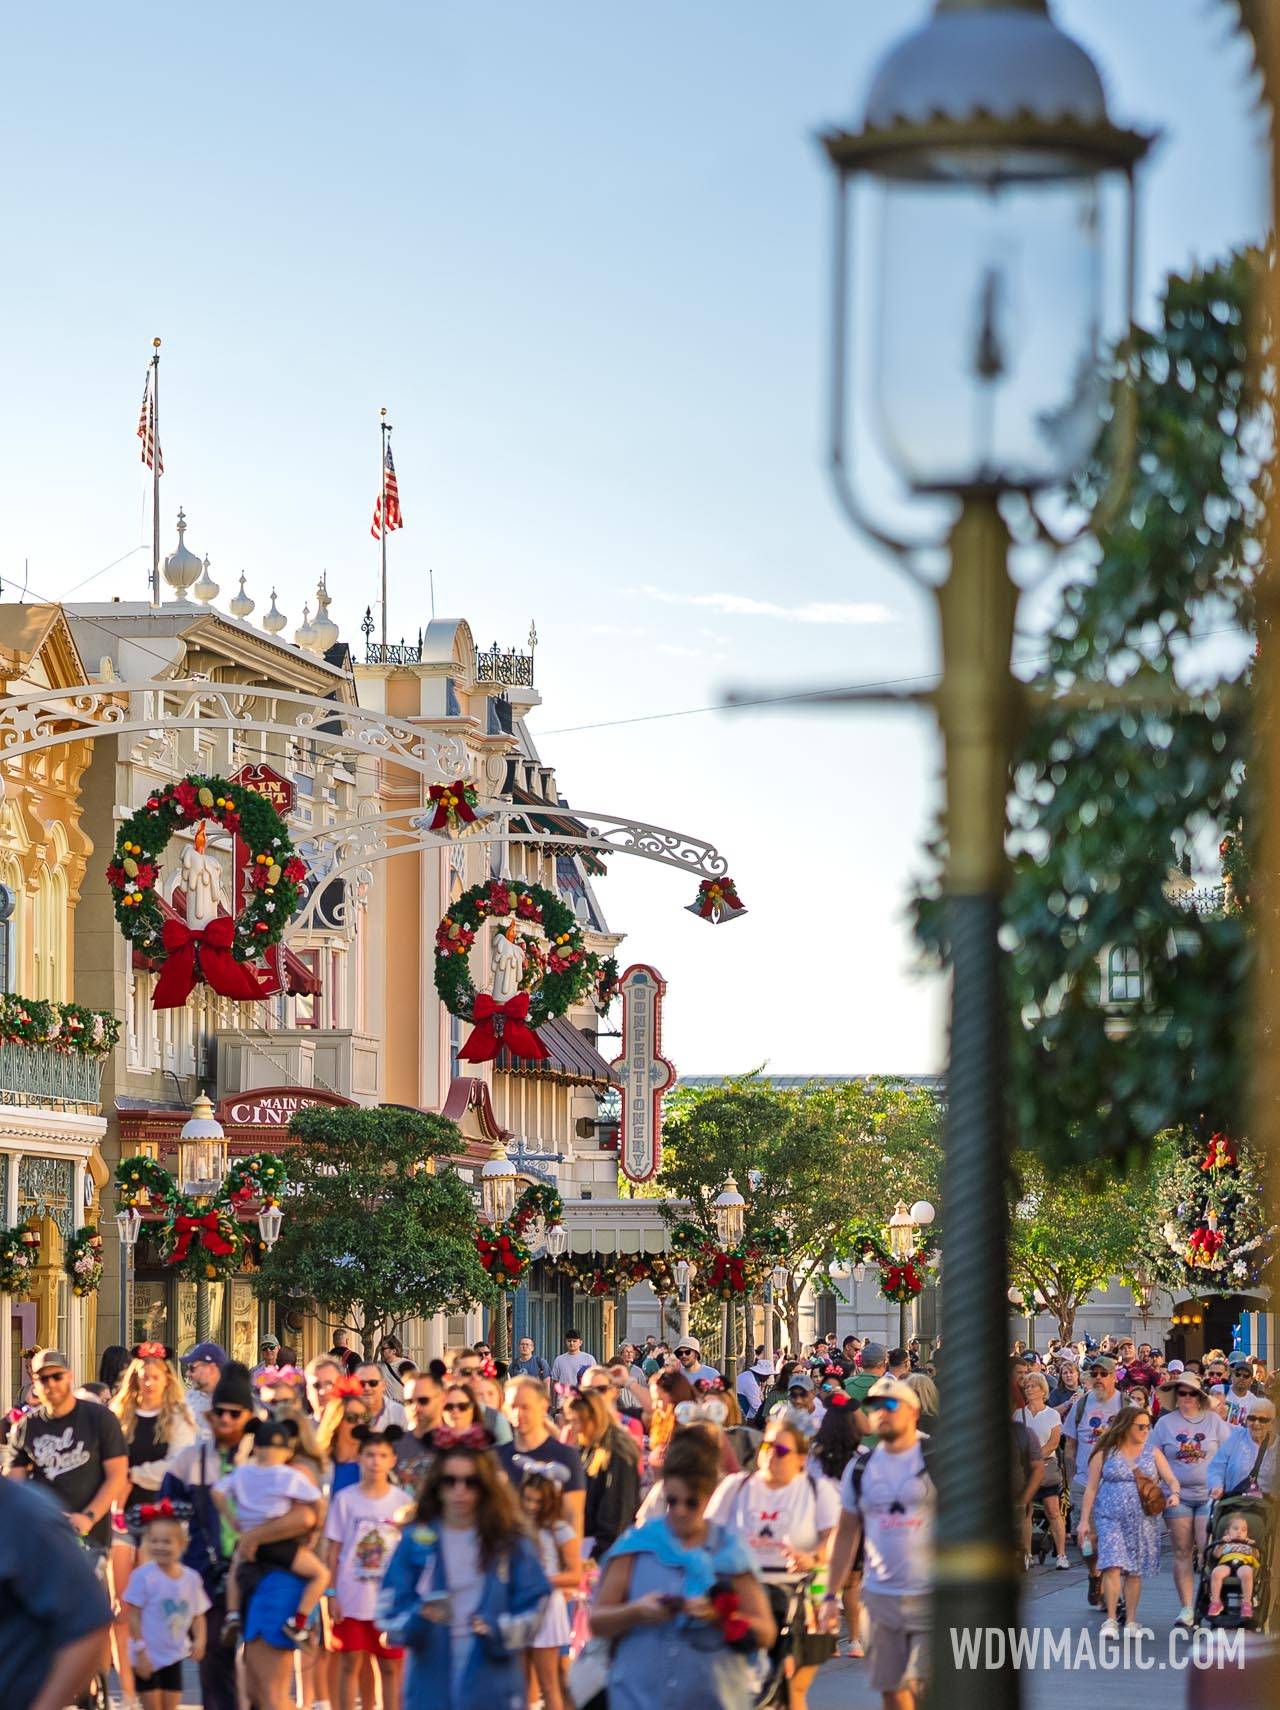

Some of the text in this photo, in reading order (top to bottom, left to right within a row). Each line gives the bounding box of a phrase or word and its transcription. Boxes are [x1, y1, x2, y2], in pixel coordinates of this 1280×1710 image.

[246, 781, 282, 793] AIN
[632, 987, 646, 1167] CONFECTIONERY
[259, 1098, 298, 1110] MAIN
